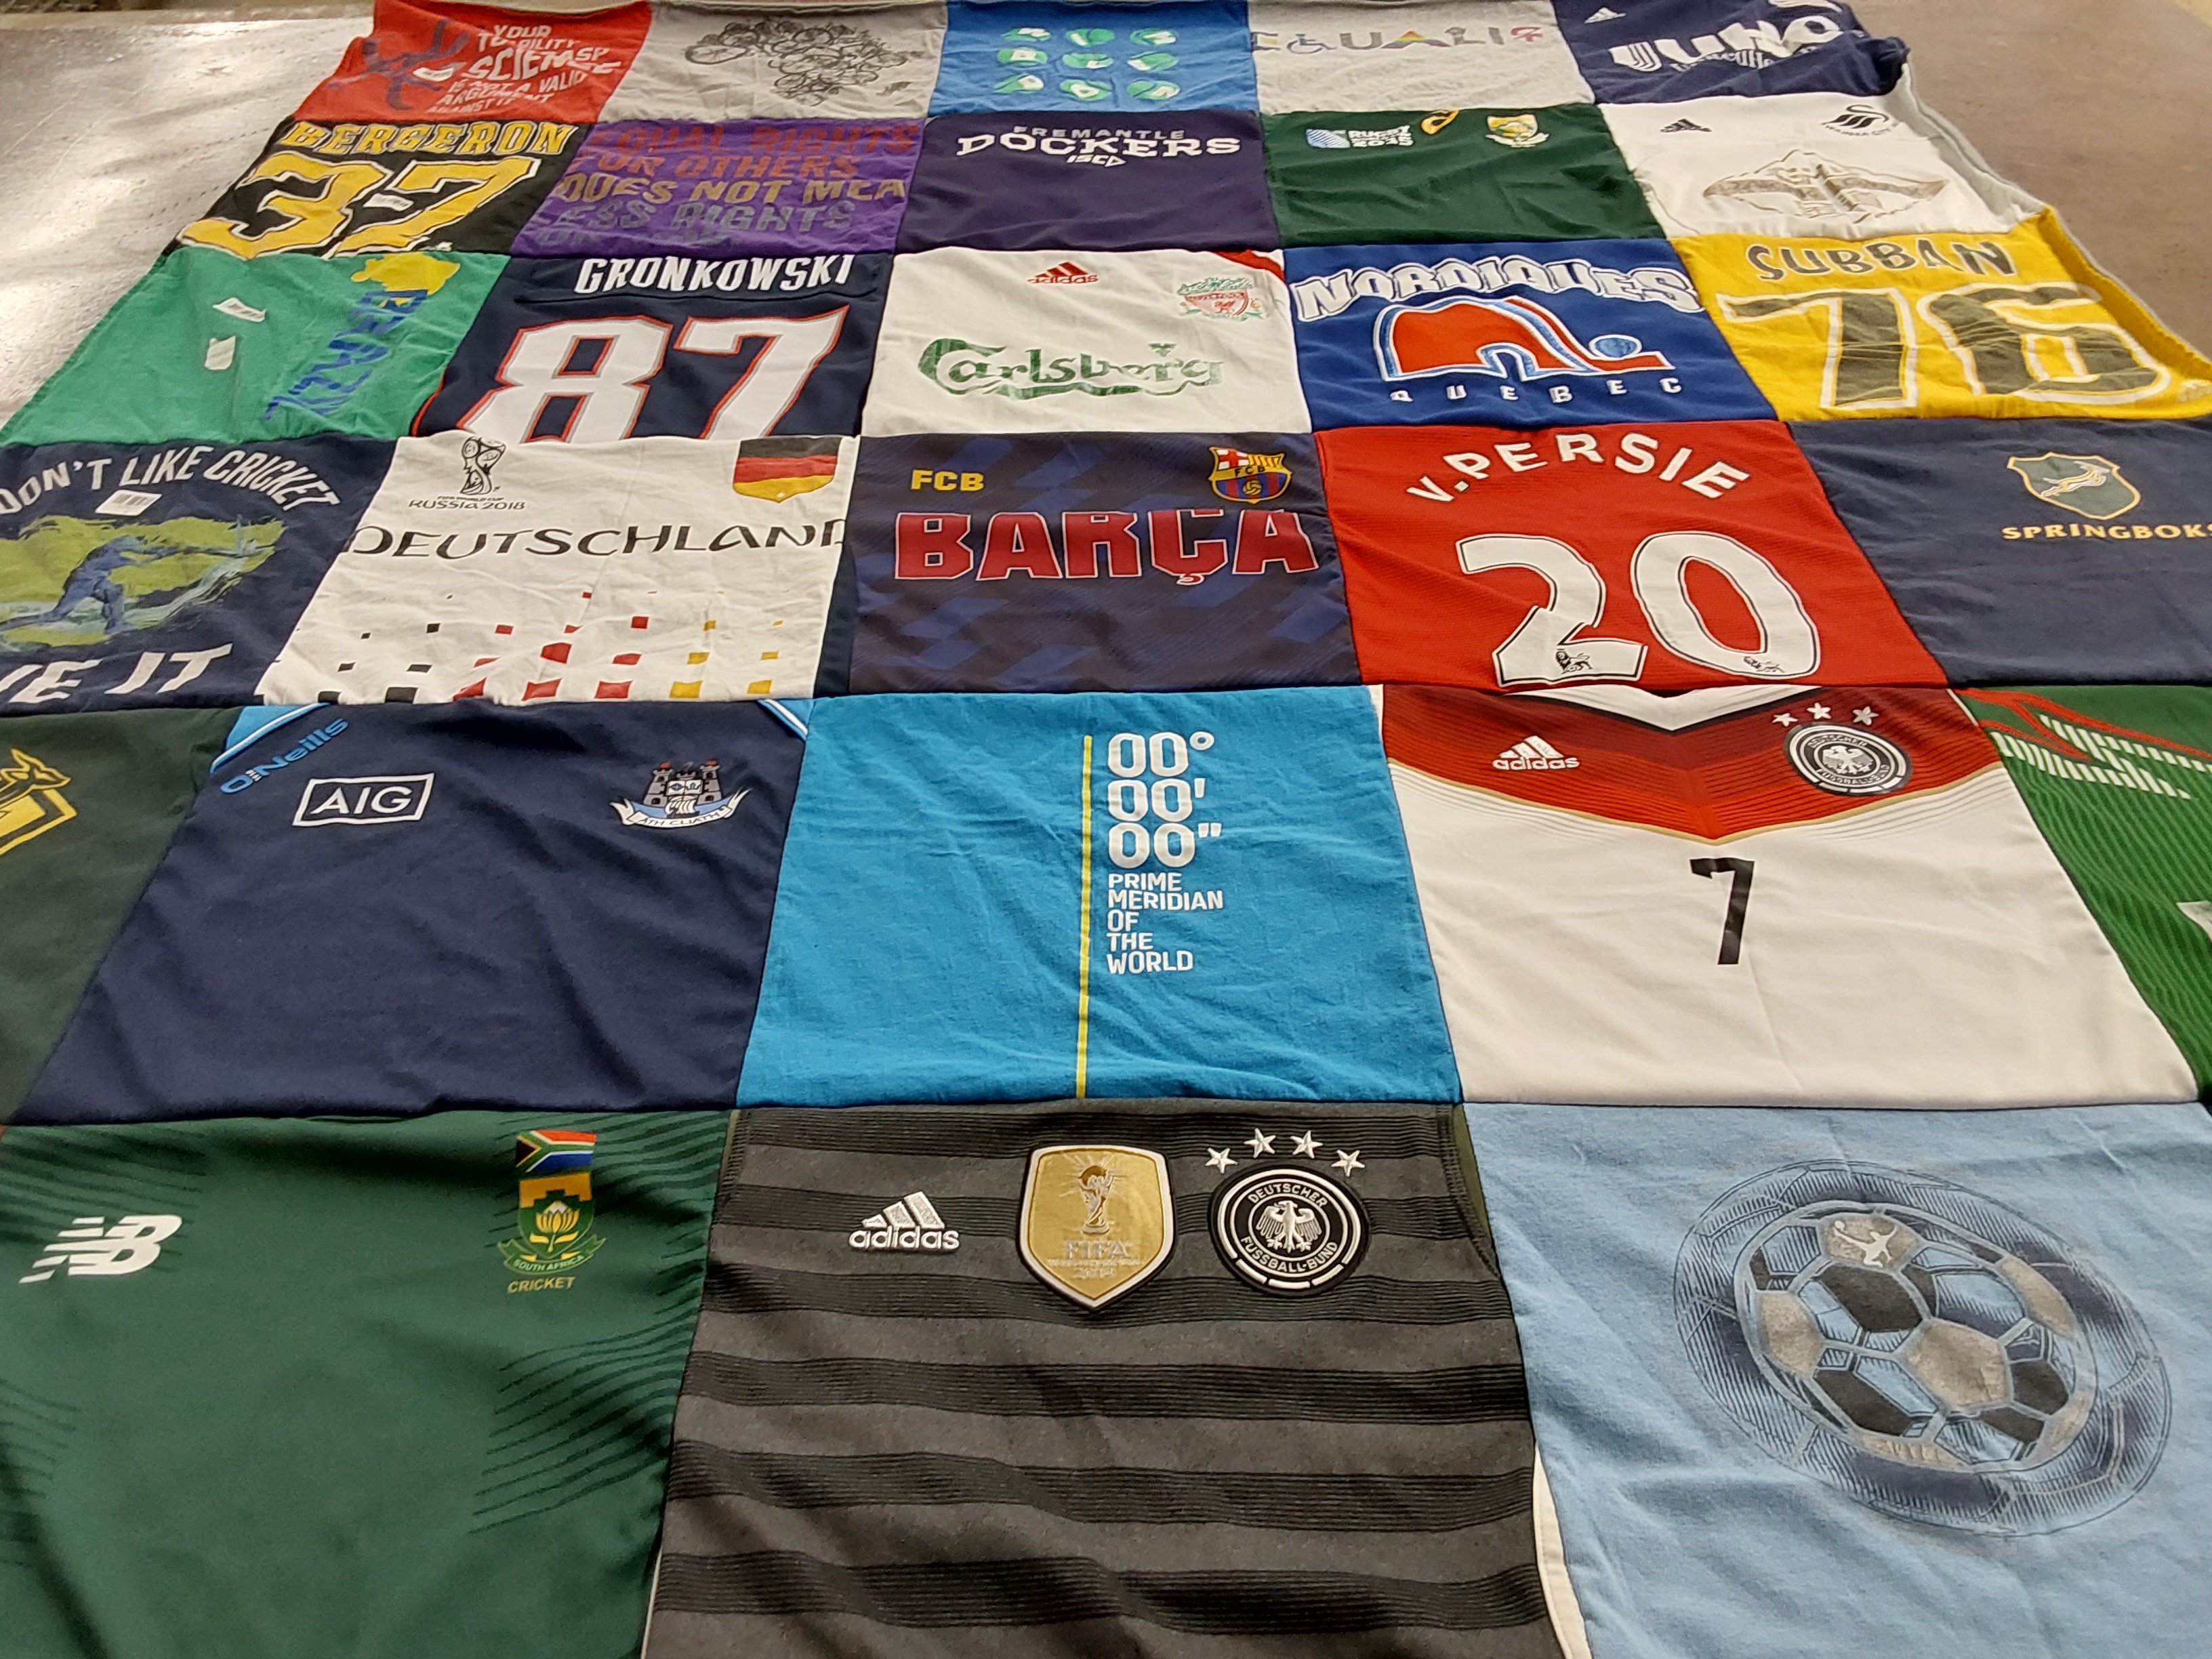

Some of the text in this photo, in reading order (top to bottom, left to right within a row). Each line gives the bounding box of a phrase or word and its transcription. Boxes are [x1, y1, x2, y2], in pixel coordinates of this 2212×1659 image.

[494, 24, 552, 38] YOUR
[539, 70, 588, 93] VALID
[280, 121, 579, 155] BERGERON
[589, 125, 920, 155] EQUAL RIGHTS
[956, 133, 1241, 157] DOCKERS
[1013, 125, 1185, 140] FREMANTLE
[676, 155, 860, 178] OTHERS
[556, 172, 678, 203] DOES
[689, 173, 792, 203] NOT
[176, 150, 541, 261] 37
[672, 201, 855, 232] RIGHTS
[1745, 239, 2016, 281] SUBBAN
[574, 254, 855, 294] GRONKOWSKI
[1290, 255, 1704, 321] NORDIQUES
[1716, 281, 2171, 409] 76
[457, 305, 850, 444] 87
[918, 337, 1224, 395] Carlsberg
[1389, 377, 1682, 403] QUEBEC
[119, 445, 214, 487] LIKE
[203, 449, 340, 512] CRICKET
[1234, 466, 1266, 478] FCB
[1407, 432, 1750, 503] V.PERSIE
[911, 469, 985, 492] FCB
[409, 499, 526, 510] RUSSIA 2018
[895, 509, 1319, 586] BARÇA
[1456, 531, 1820, 688] 20
[1492, 756, 1580, 771] adidas
[310, 786, 413, 815] AIG
[1108, 872, 1183, 892] PRIME
[1107, 889, 1224, 911] MERIDIAN
[1689, 857, 1756, 965] 7
[1107, 909, 1140, 933] OF
[1106, 932, 1153, 952] THE
[1107, 950, 1194, 975] WORLD
[1248, 1183, 1328, 1208] DEUTSCHER
[848, 1225, 960, 1250] adidas
[1065, 1240, 1128, 1259] FIFA
[513, 1254, 586, 1272] SOUTH AFRICA
[1241, 1236, 1338, 1273] FUSSBALL-BUND
[508, 1276, 575, 1294] CRICKET
